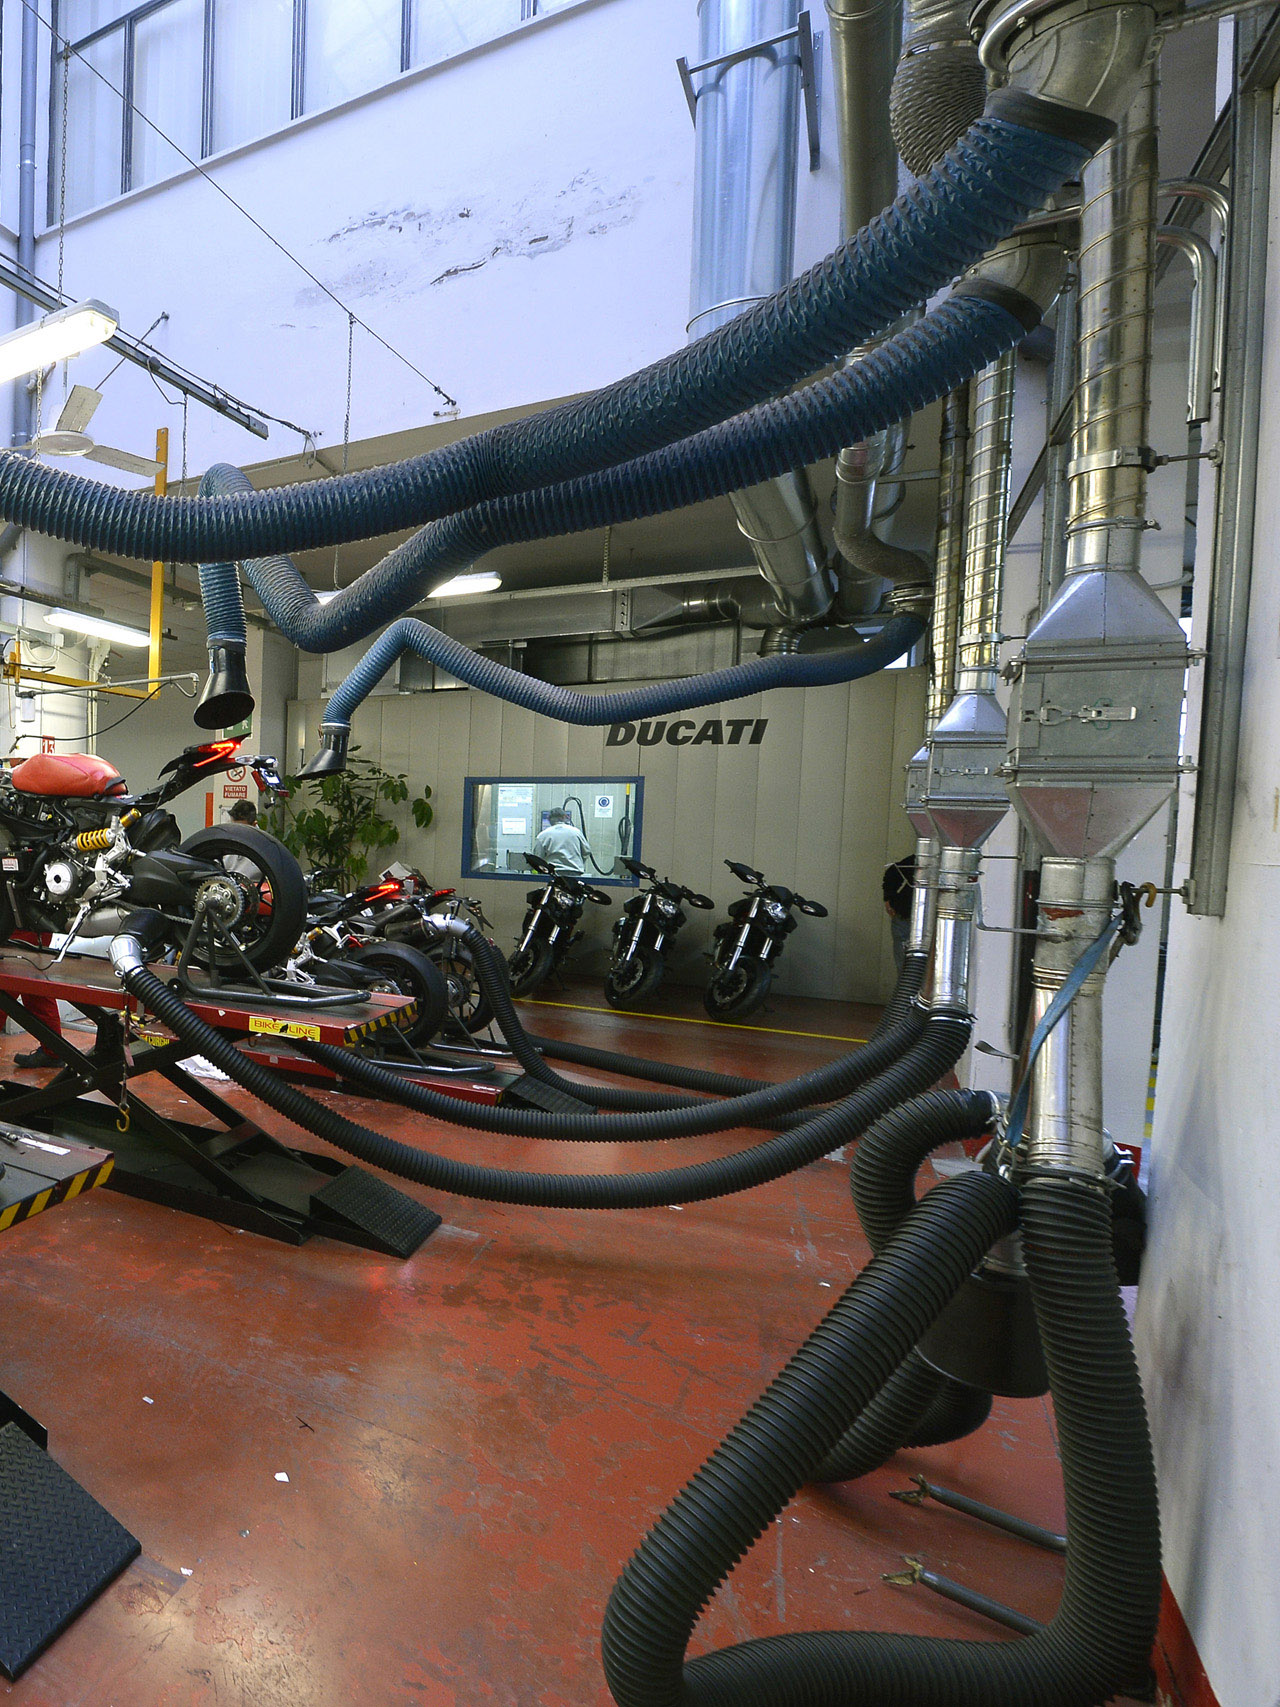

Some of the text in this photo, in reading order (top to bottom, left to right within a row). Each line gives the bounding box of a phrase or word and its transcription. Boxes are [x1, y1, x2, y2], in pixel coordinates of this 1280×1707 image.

[606, 719, 769, 746] DUCATI
[254, 1019, 316, 1036] BIKE LINE
